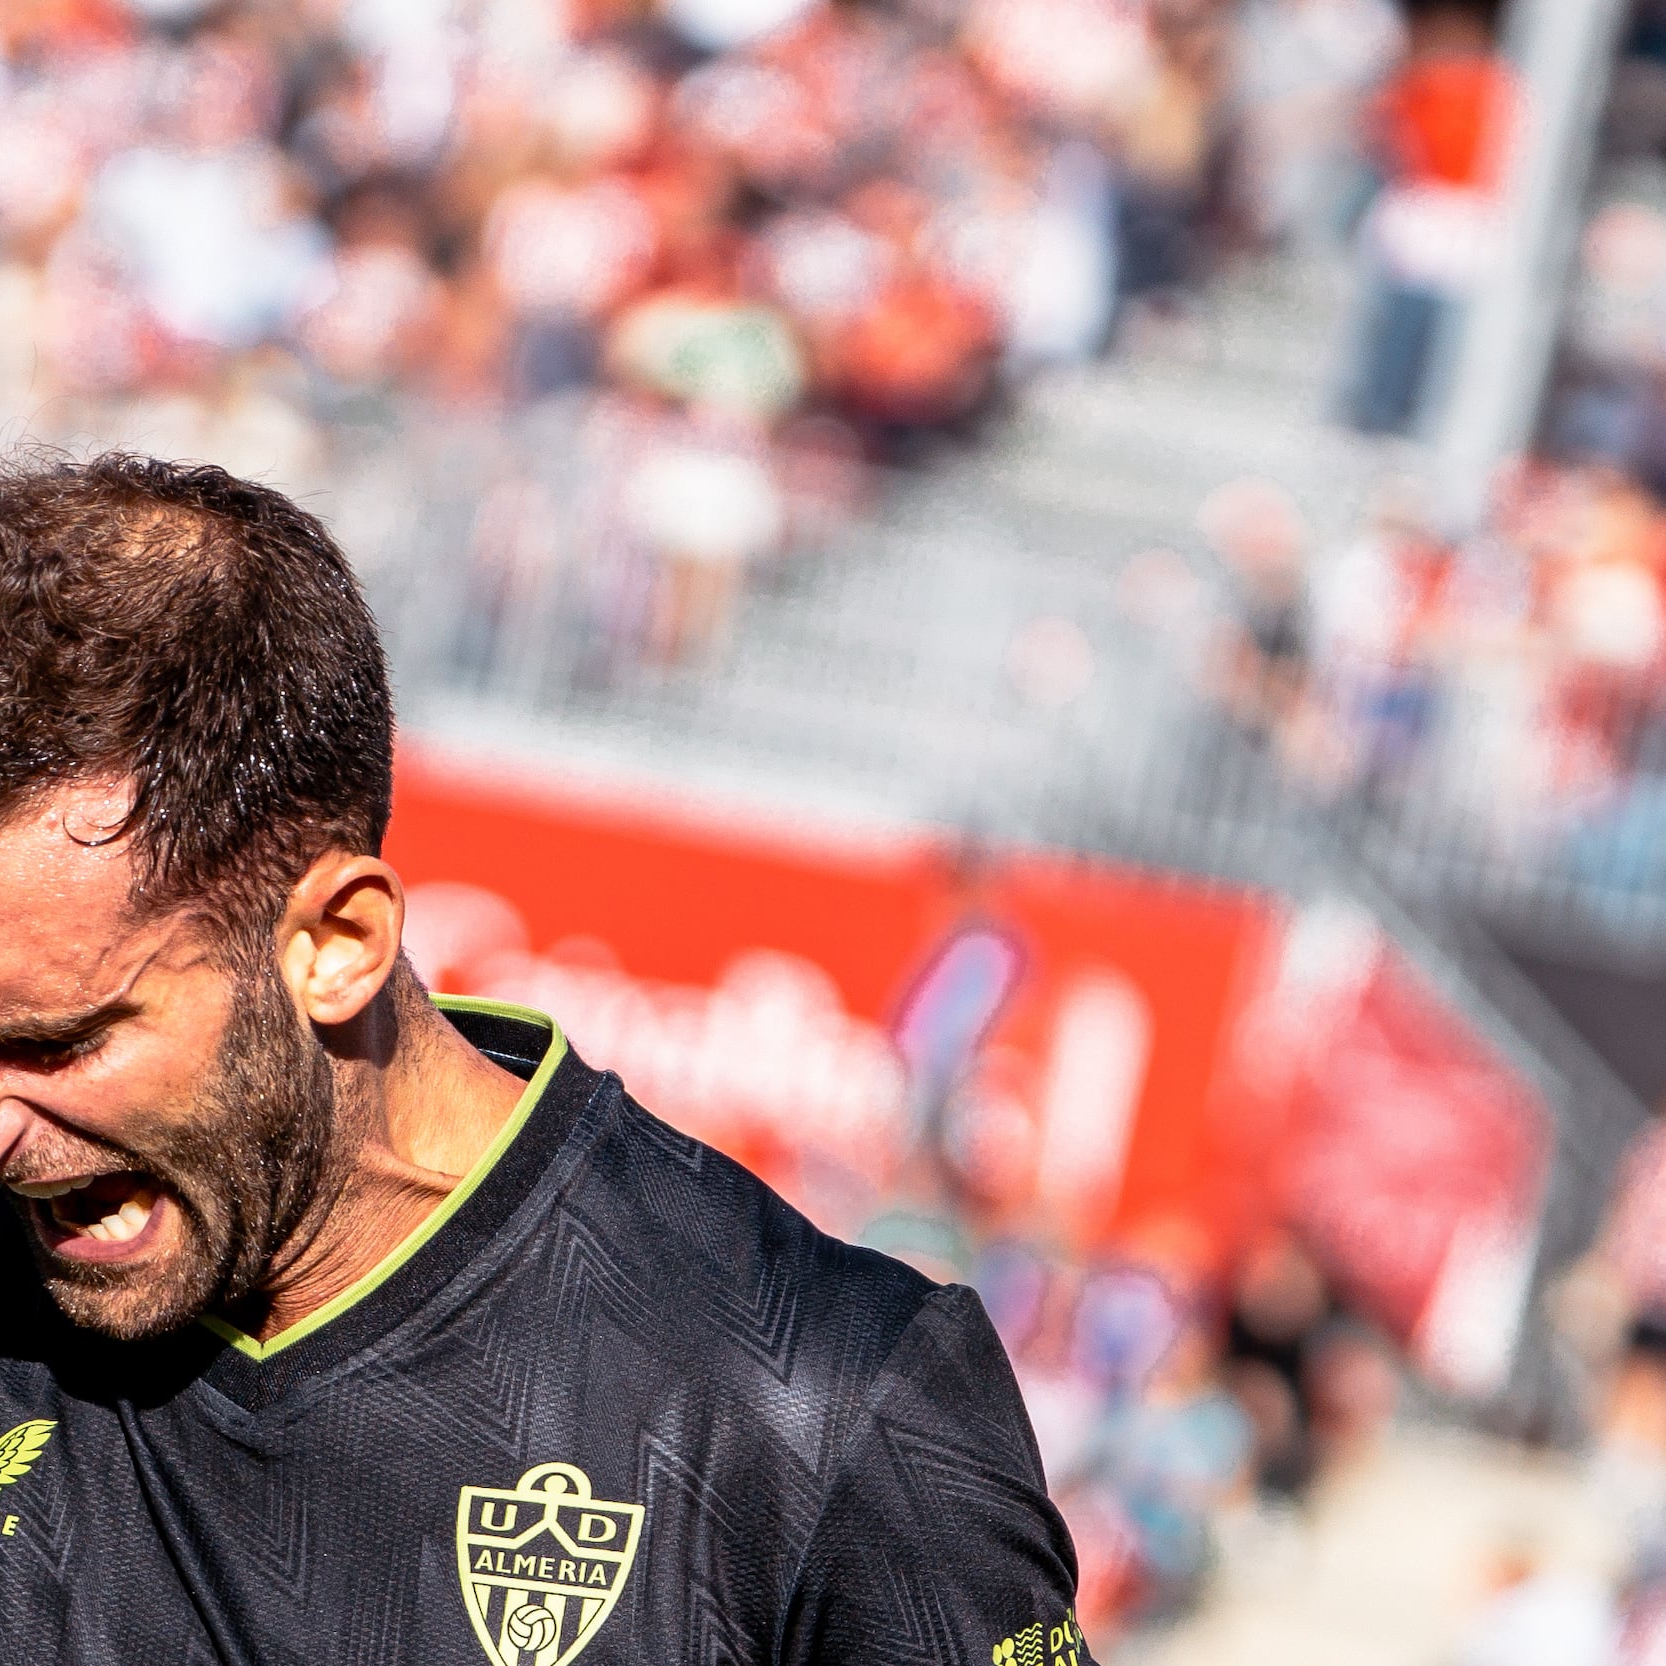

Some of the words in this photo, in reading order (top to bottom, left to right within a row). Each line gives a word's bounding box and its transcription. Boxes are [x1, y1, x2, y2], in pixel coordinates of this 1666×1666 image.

[480, 1501, 518, 1532] U
[577, 1512, 617, 1543] D
[473, 1549, 608, 1586] ALMERIA
